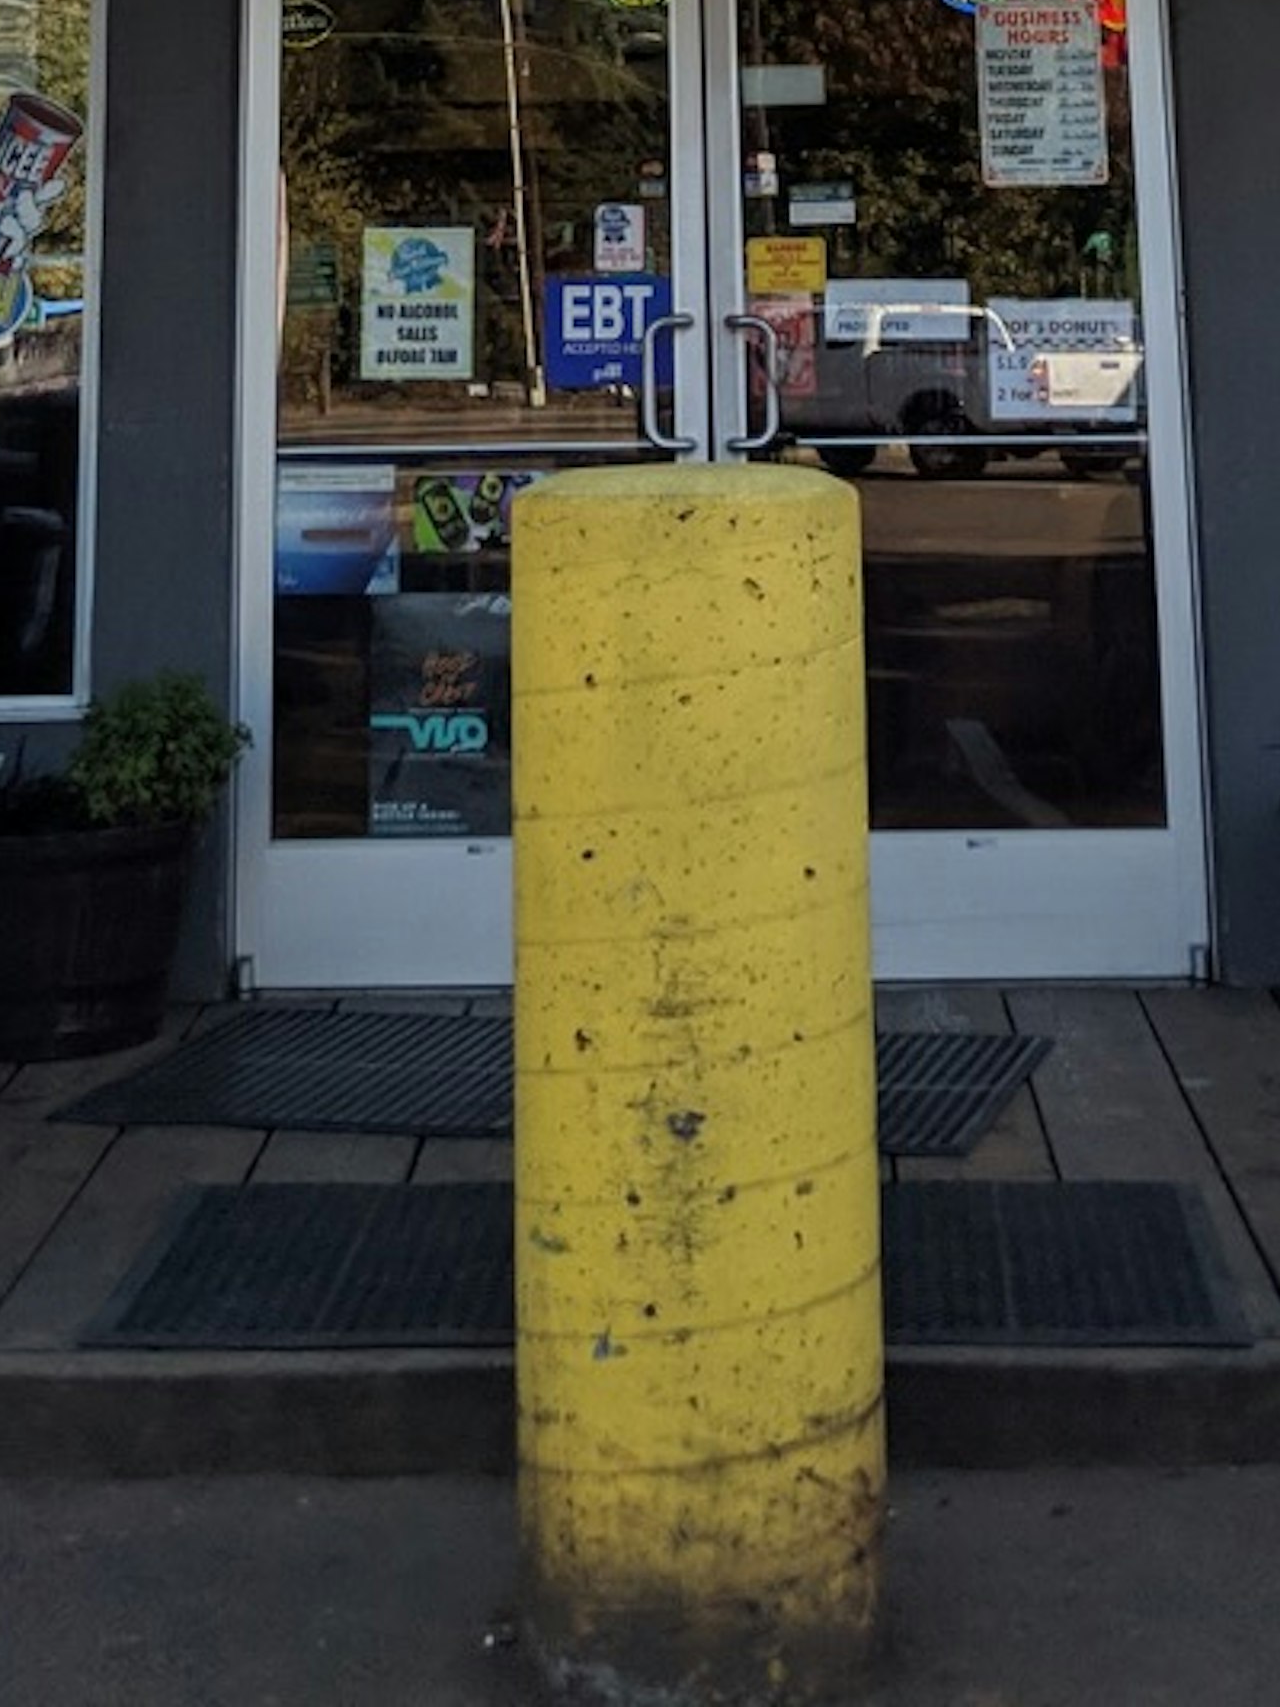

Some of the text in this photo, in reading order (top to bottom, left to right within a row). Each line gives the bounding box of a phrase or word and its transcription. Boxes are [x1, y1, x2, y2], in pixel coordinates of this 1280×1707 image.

[994, 10, 1082, 27] BUSINESS
[1007, 28, 1071, 45] HOURS
[561, 284, 655, 341] EBT
[397, 325, 439, 341] SALES
